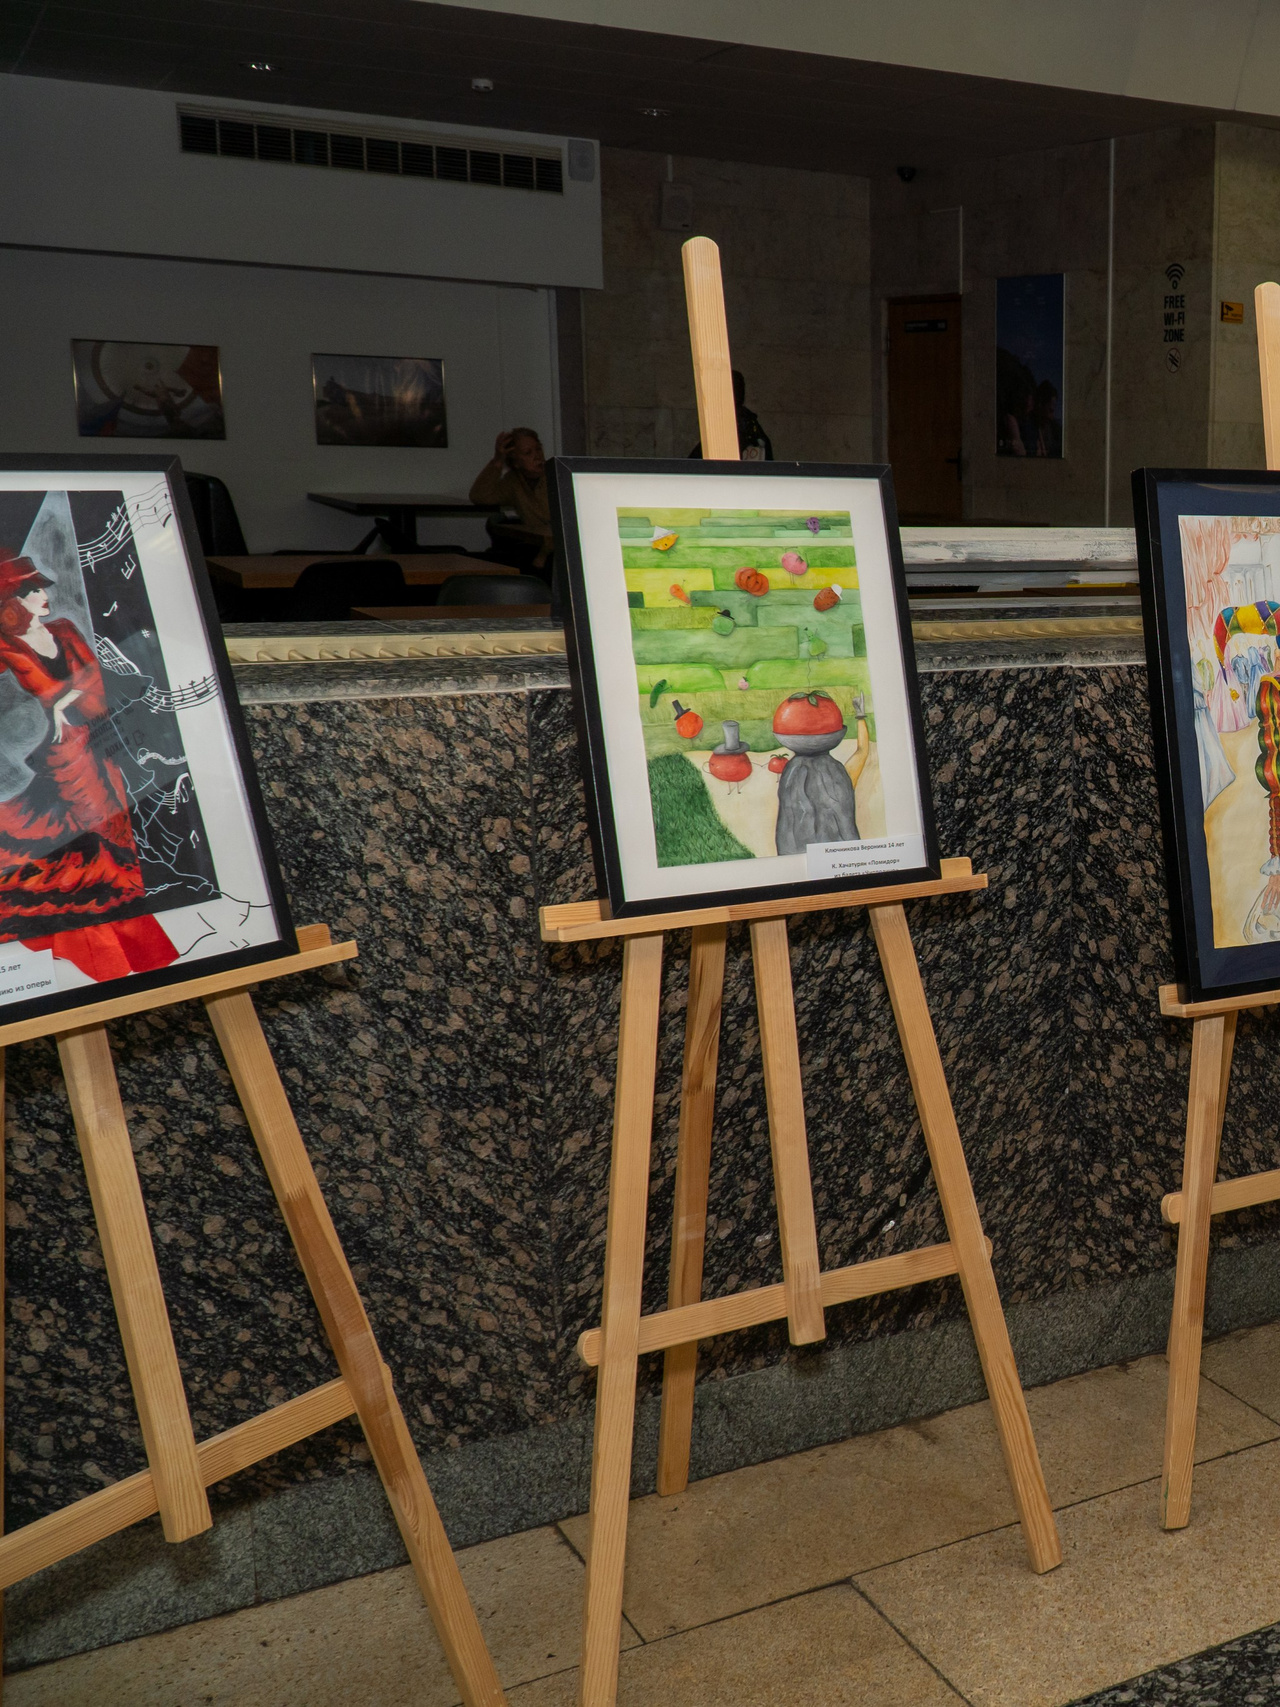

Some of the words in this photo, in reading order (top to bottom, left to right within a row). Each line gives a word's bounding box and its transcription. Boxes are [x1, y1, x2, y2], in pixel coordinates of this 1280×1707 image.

[1164, 295, 1185, 309] FREE
[1163, 311, 1185, 326] WI-FI
[1163, 328, 1185, 342] ZONE
[825, 846, 860, 854] Ключникова
[861, 843, 887, 851] Вероника
[838, 861, 867, 869] Хачатурян
[868, 858, 900, 866] «Помидор»
[8, 963, 21, 972] лет
[26, 979, 52, 989] оперы
